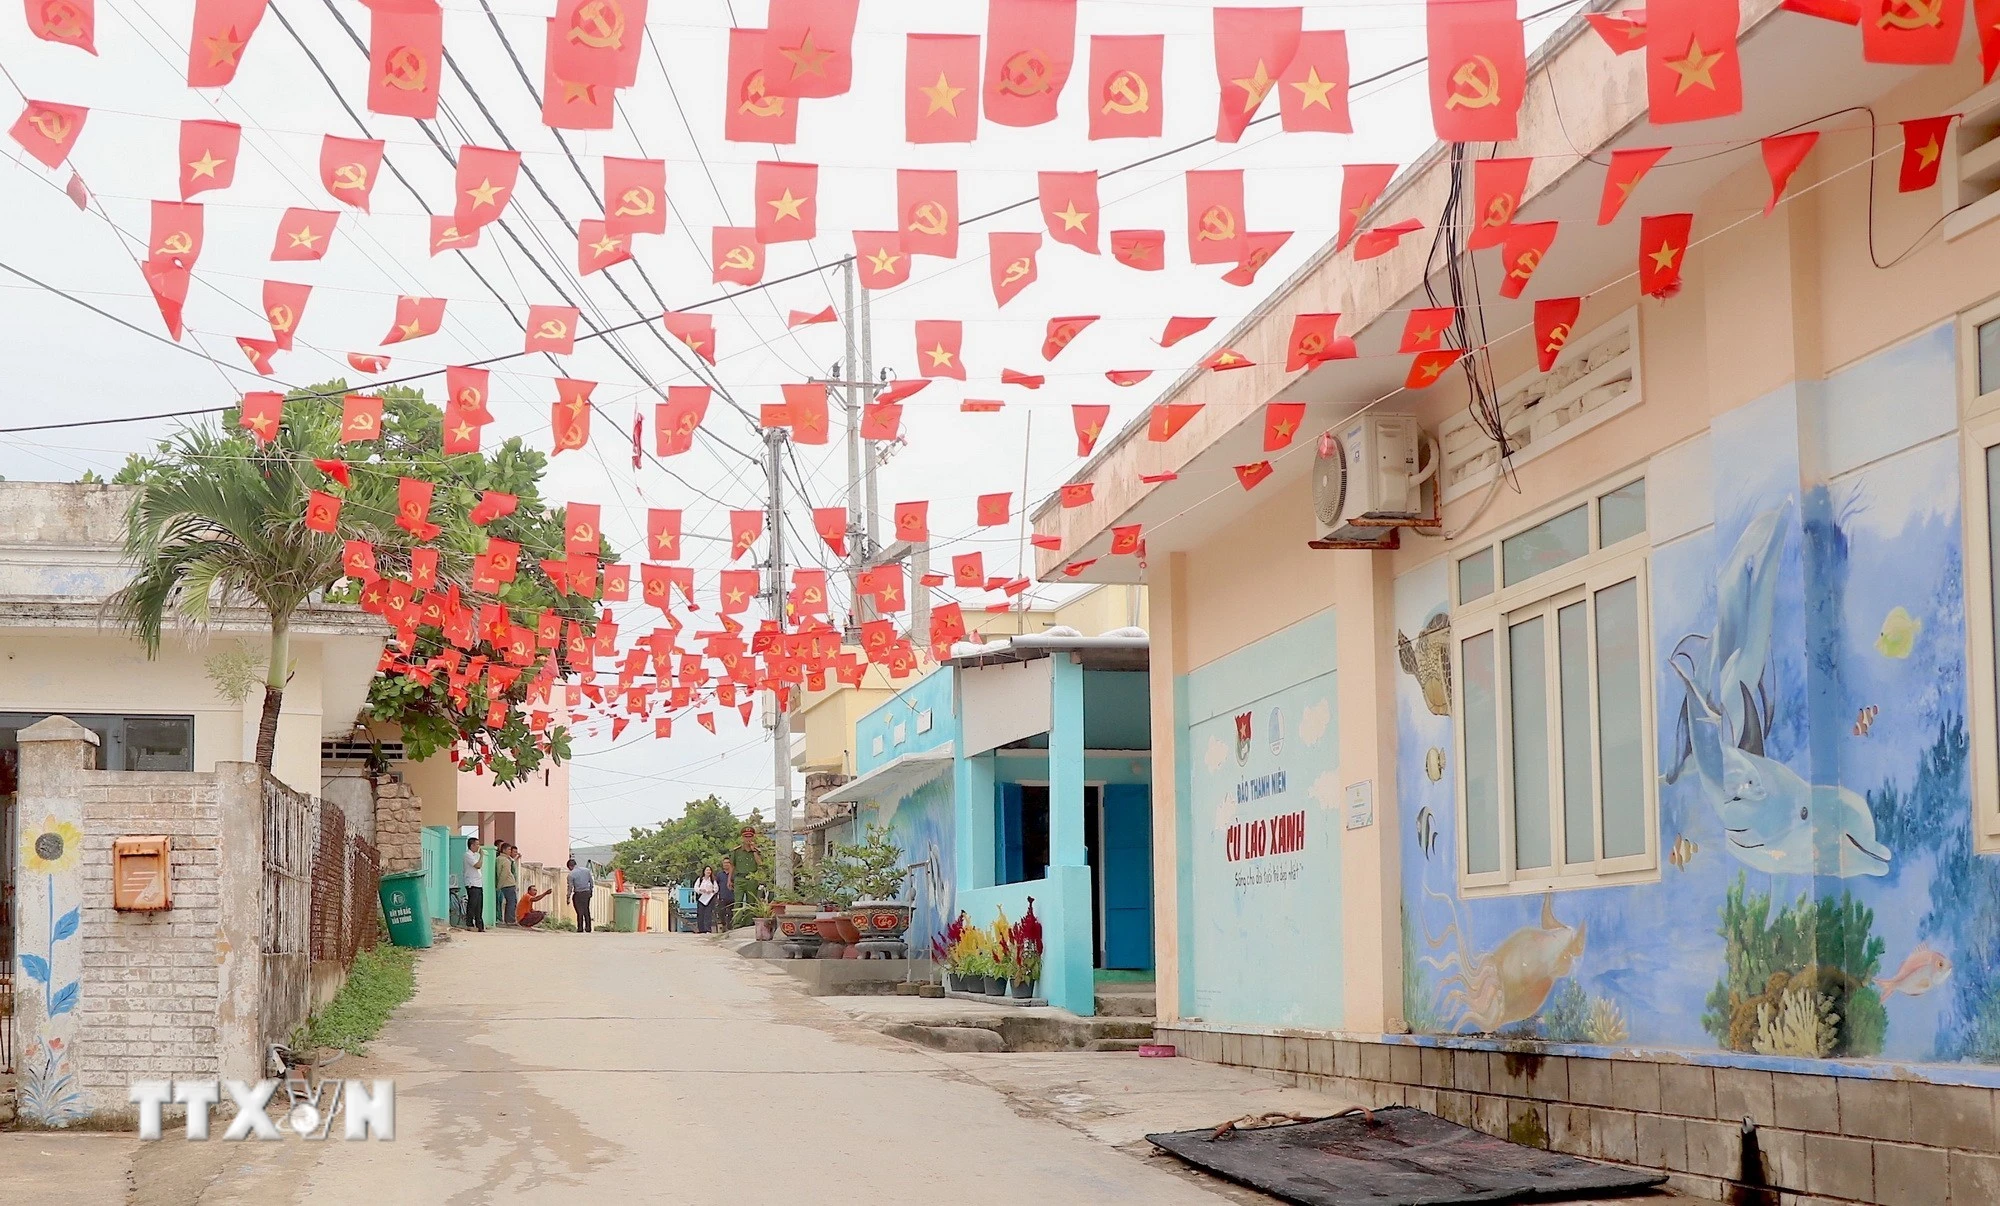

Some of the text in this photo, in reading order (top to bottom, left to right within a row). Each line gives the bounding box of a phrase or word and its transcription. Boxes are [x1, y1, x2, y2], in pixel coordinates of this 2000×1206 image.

[1250, 774, 1270, 801] THANH
[1271, 767, 1286, 795] NIÊN
[1226, 810, 1304, 862] CÙ LAO XANH
